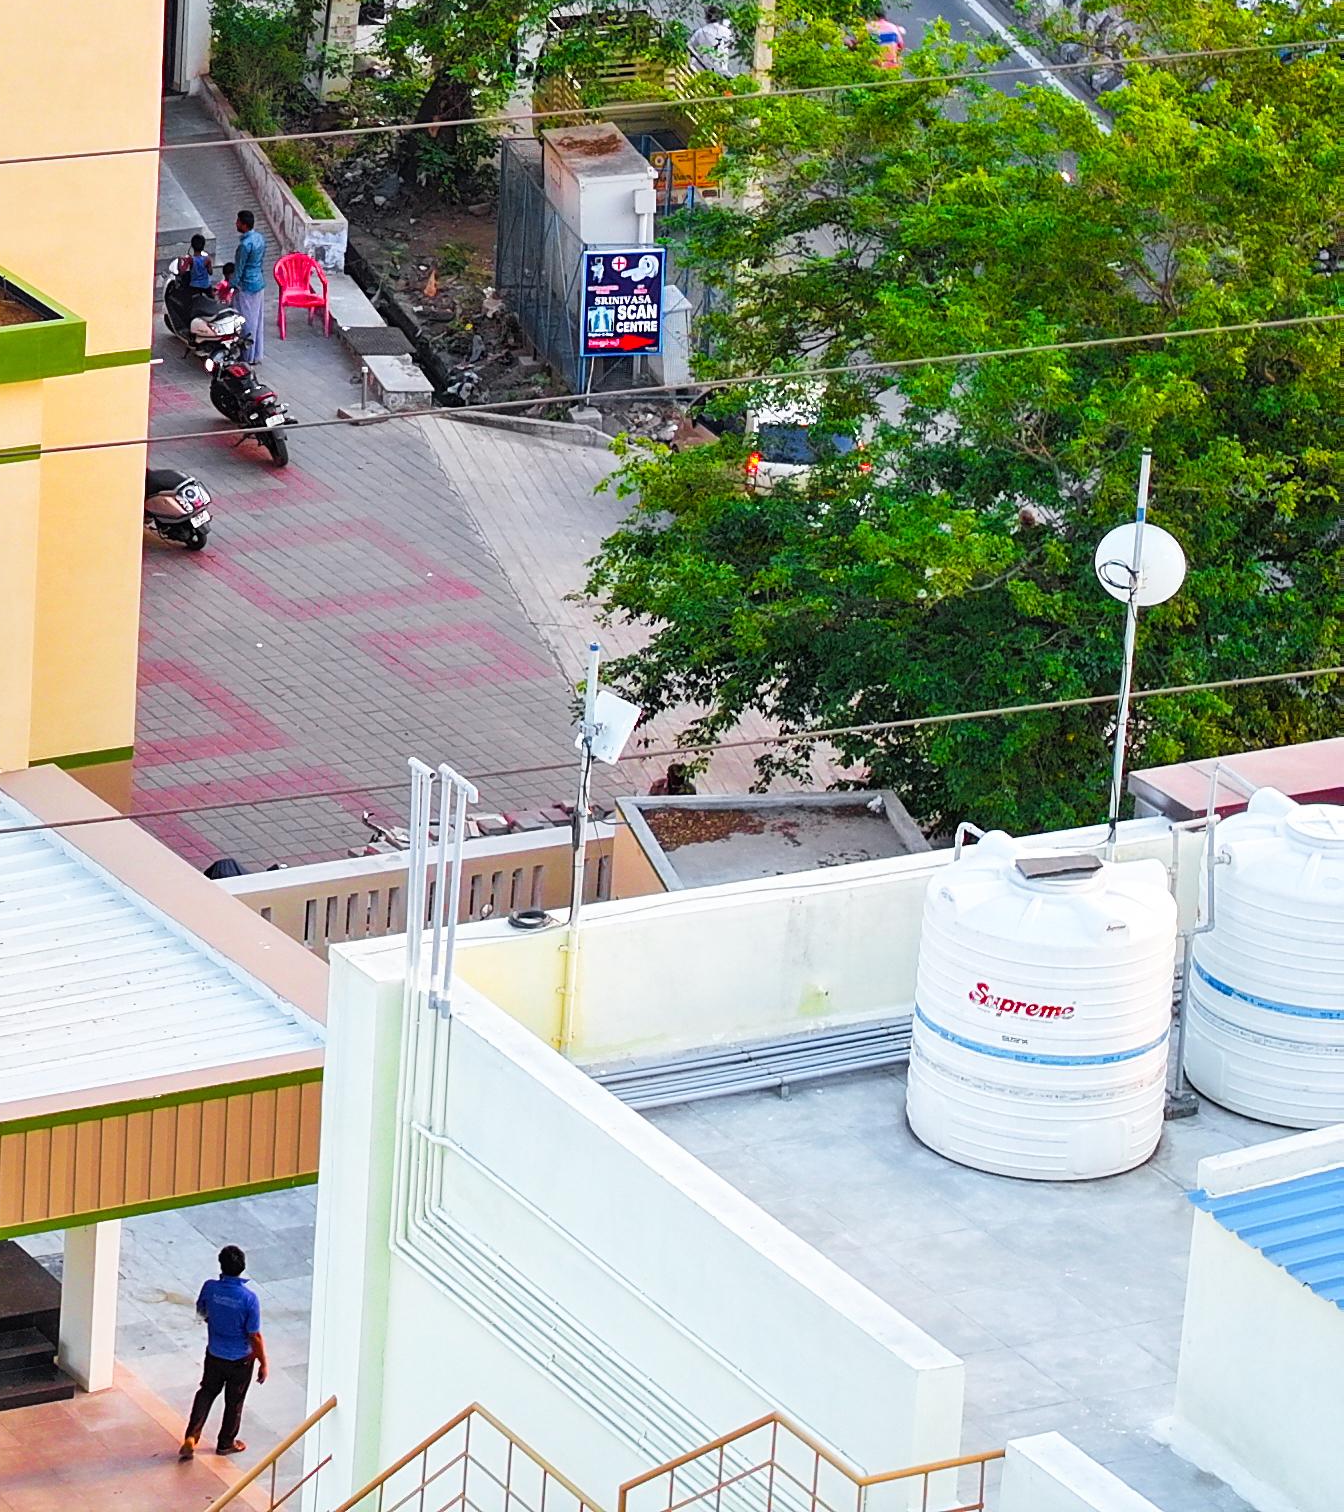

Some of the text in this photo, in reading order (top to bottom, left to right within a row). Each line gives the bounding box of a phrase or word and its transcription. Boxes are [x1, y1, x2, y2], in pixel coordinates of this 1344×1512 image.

[594, 294, 652, 306] SRINIVASA
[617, 303, 658, 320] SCAN
[616, 320, 658, 333] CENTRE
[968, 982, 1075, 1021] Supreme
